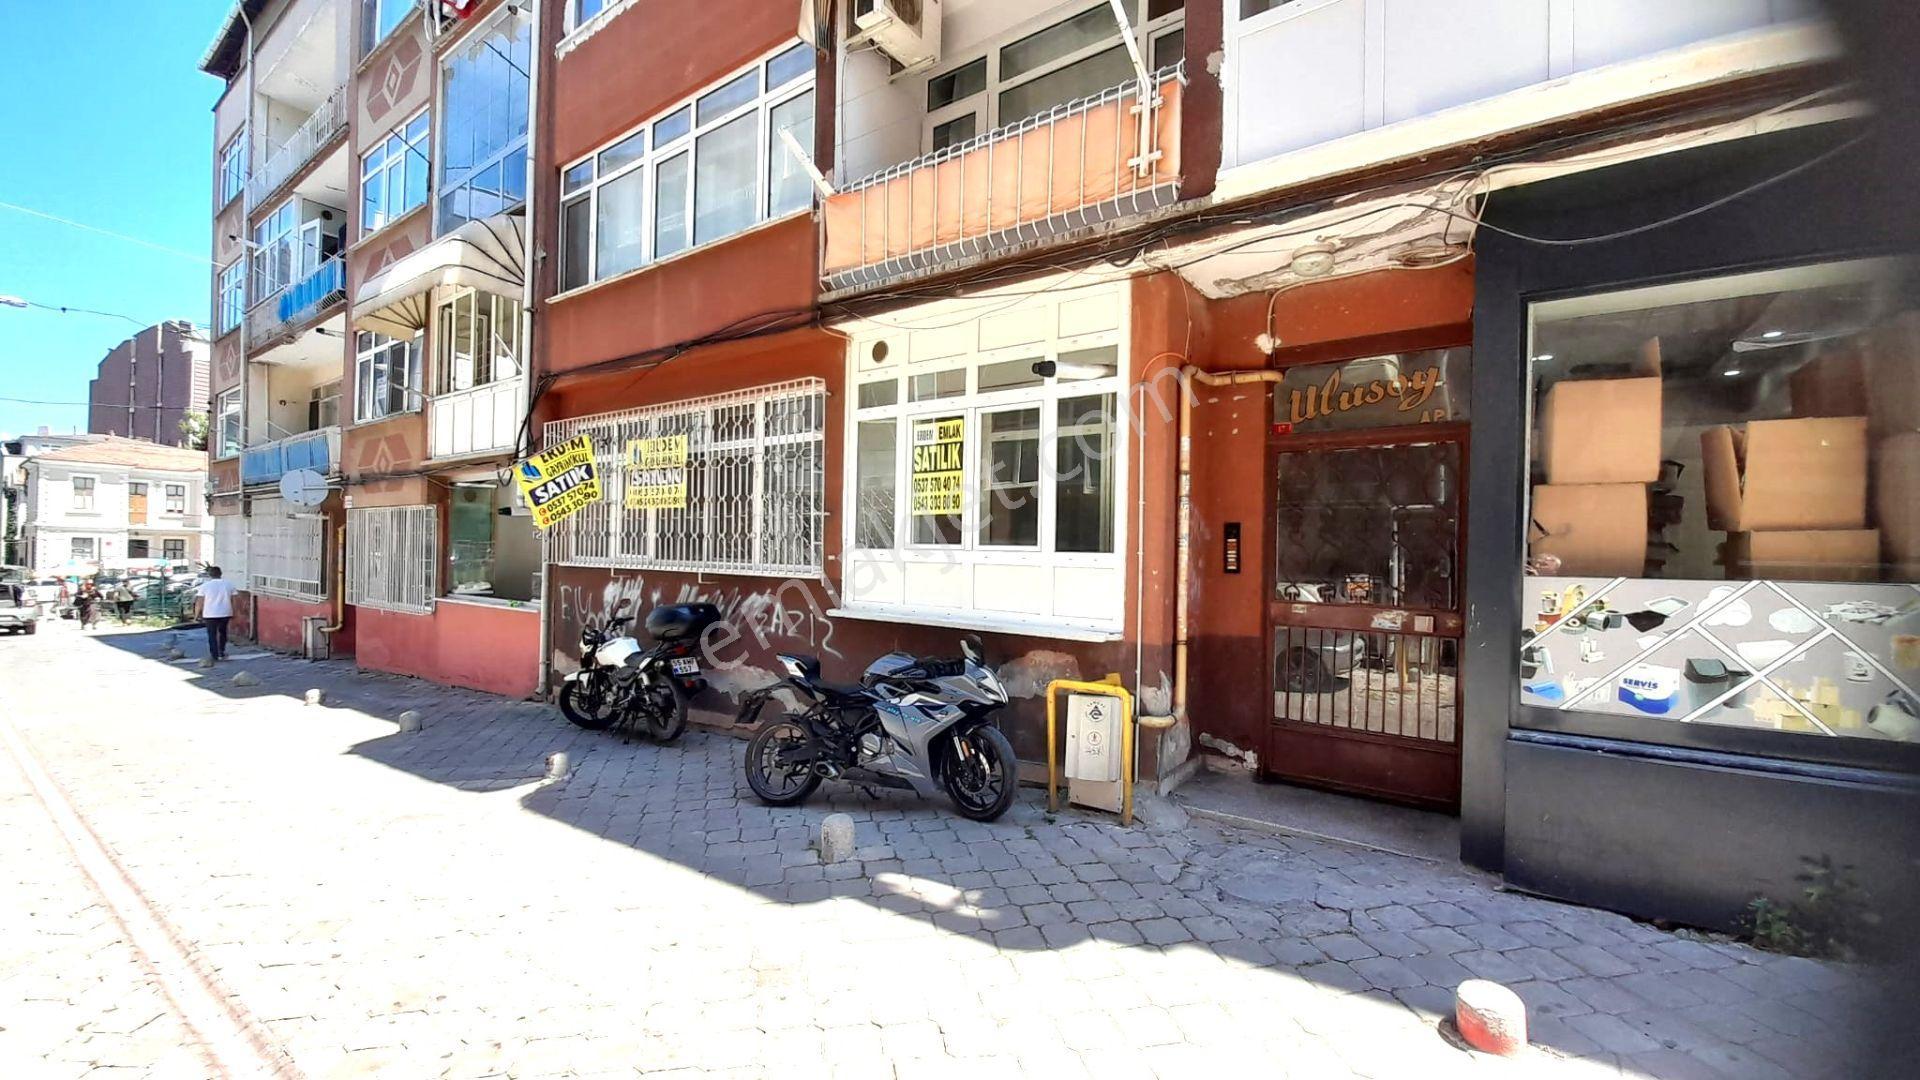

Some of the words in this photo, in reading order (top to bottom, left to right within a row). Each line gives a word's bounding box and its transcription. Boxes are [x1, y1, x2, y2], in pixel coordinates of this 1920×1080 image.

[938, 424, 962, 440] EMLAK
[914, 443, 962, 472] SATILIK
[547, 494, 566, 513] 0537
